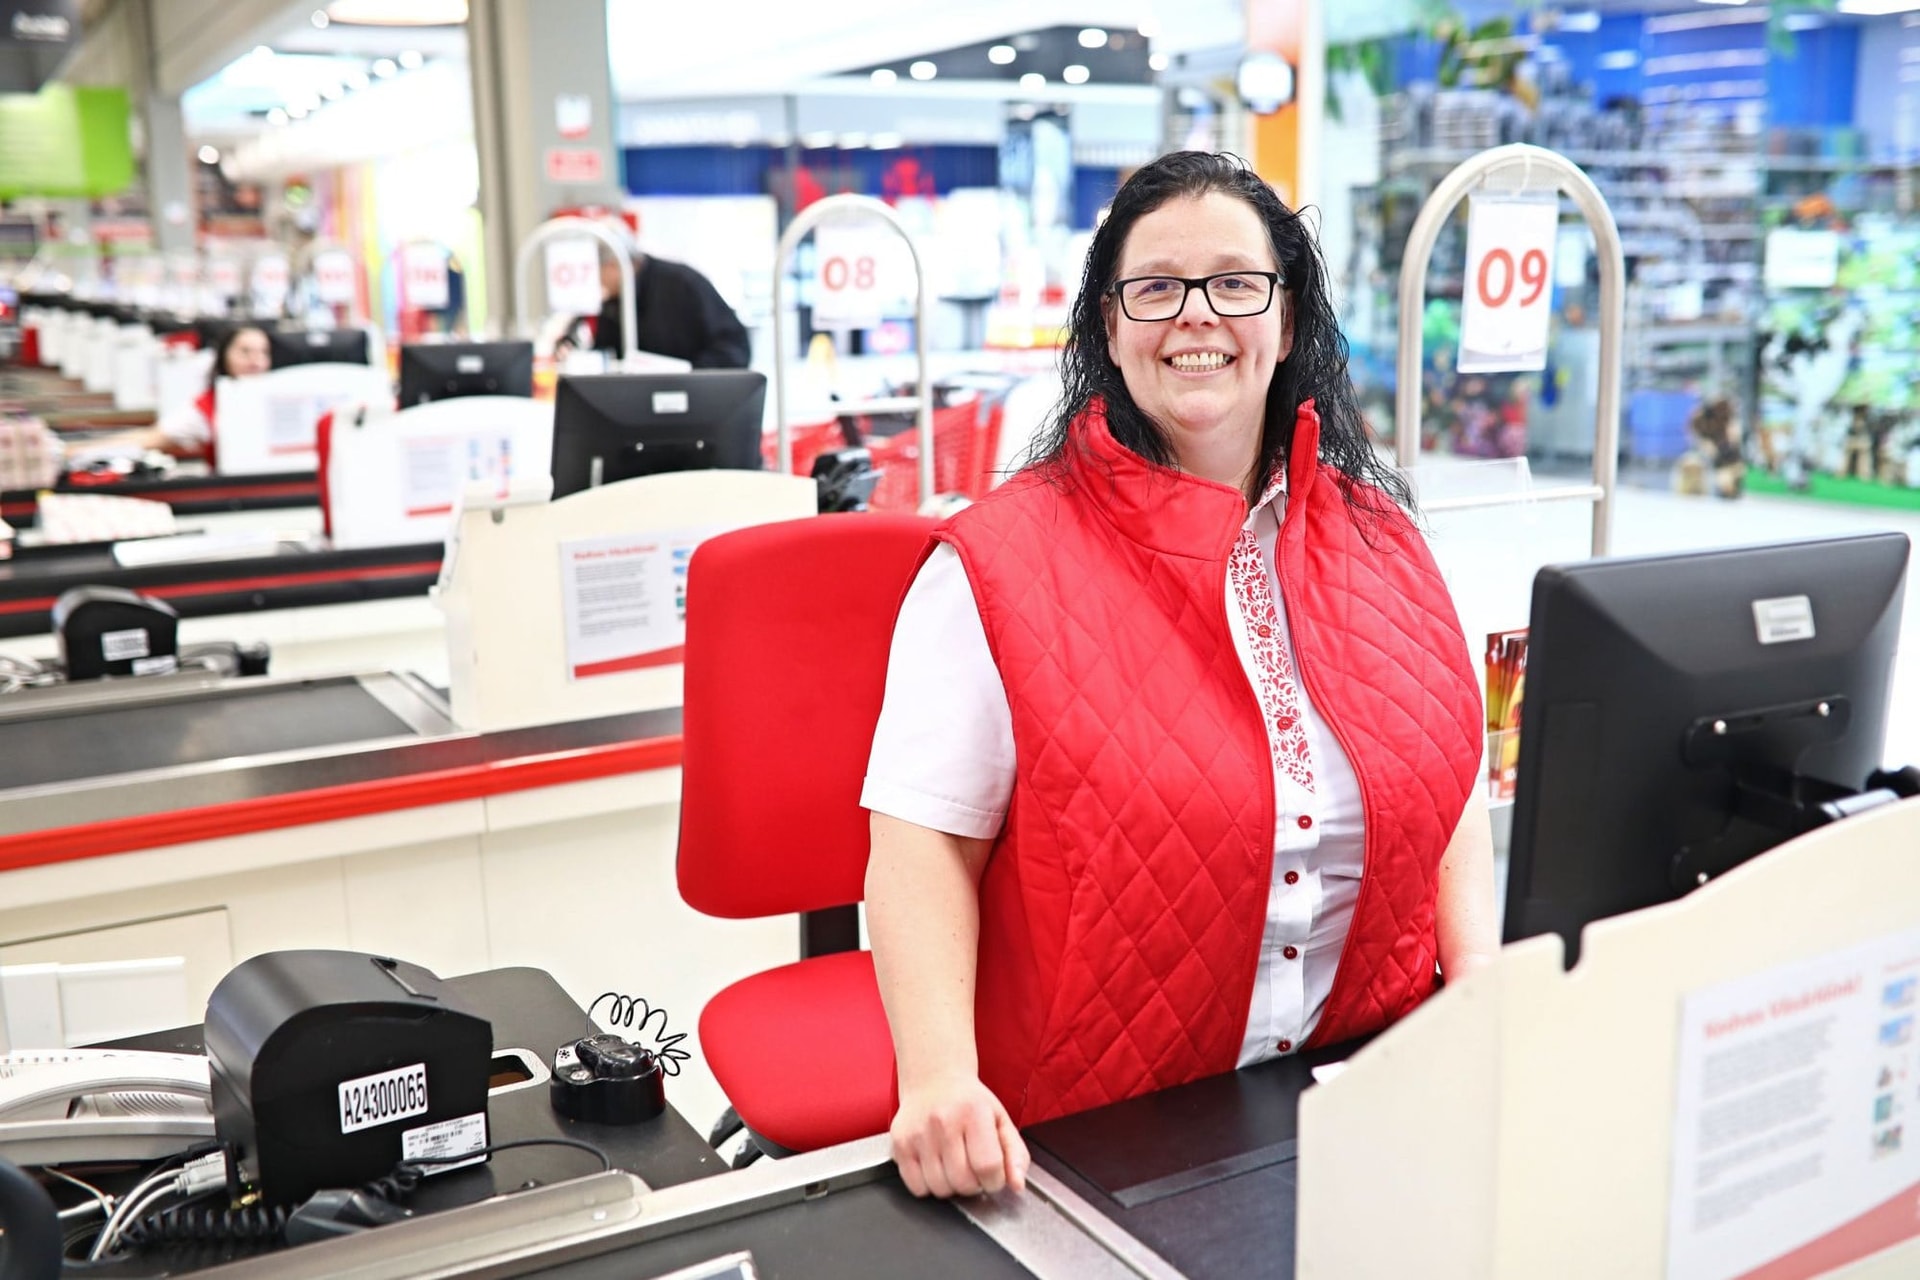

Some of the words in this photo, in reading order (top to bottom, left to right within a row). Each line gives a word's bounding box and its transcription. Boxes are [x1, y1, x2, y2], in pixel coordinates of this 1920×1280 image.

[822, 254, 877, 294] 08
[1477, 247, 1547, 309] 09
[344, 1072, 426, 1127] A24300065
